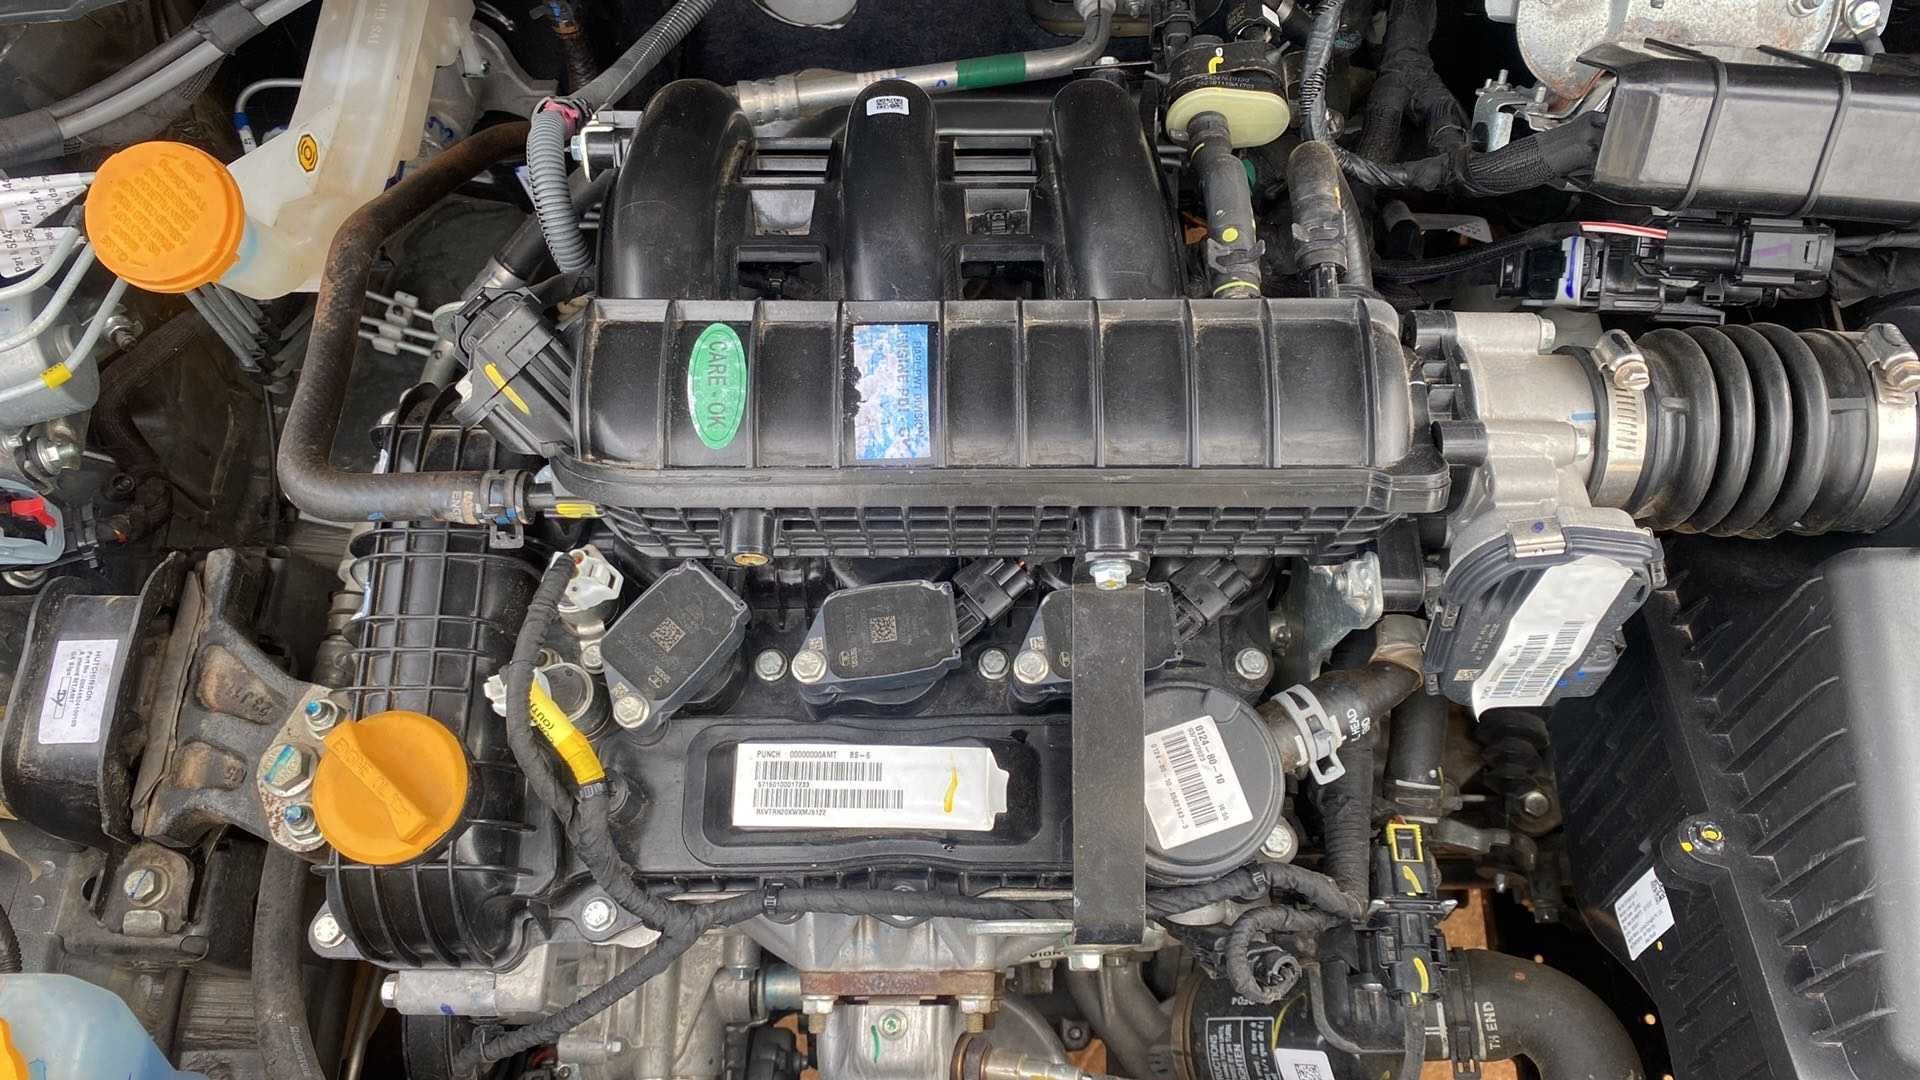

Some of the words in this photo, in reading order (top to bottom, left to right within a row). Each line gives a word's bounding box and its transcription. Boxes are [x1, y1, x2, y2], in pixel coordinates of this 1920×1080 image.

[707, 341, 728, 386] CARE
[706, 402, 726, 430] OK
[86, 650, 102, 702] HUTCHINSON
[757, 750, 781, 759] PUNCH
[1483, 1001, 1498, 1032] END
